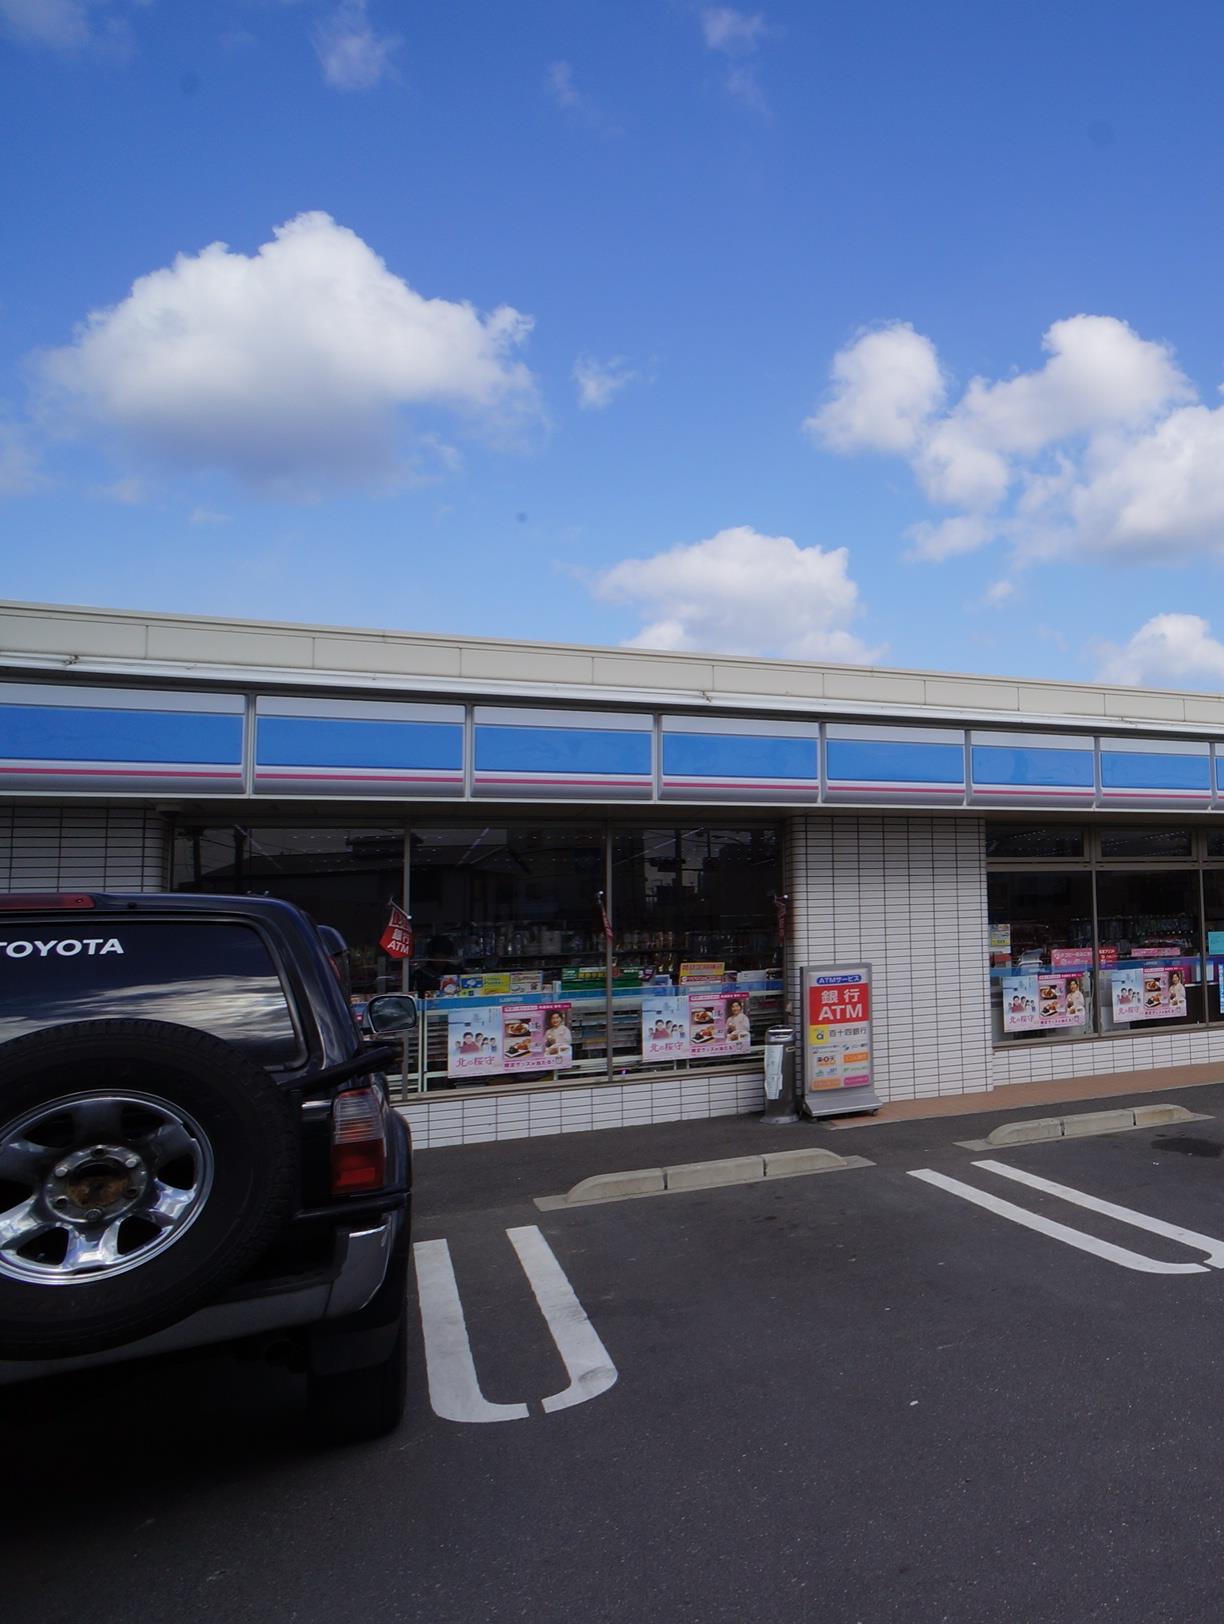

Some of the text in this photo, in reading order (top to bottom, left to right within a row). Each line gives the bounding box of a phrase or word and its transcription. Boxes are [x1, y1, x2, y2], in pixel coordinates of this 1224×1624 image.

[387, 940, 409, 955] ATM
[818, 975, 860, 984] ATMサービス
[821, 988, 861, 1004] 銀行
[818, 1003, 863, 1021] ATM
